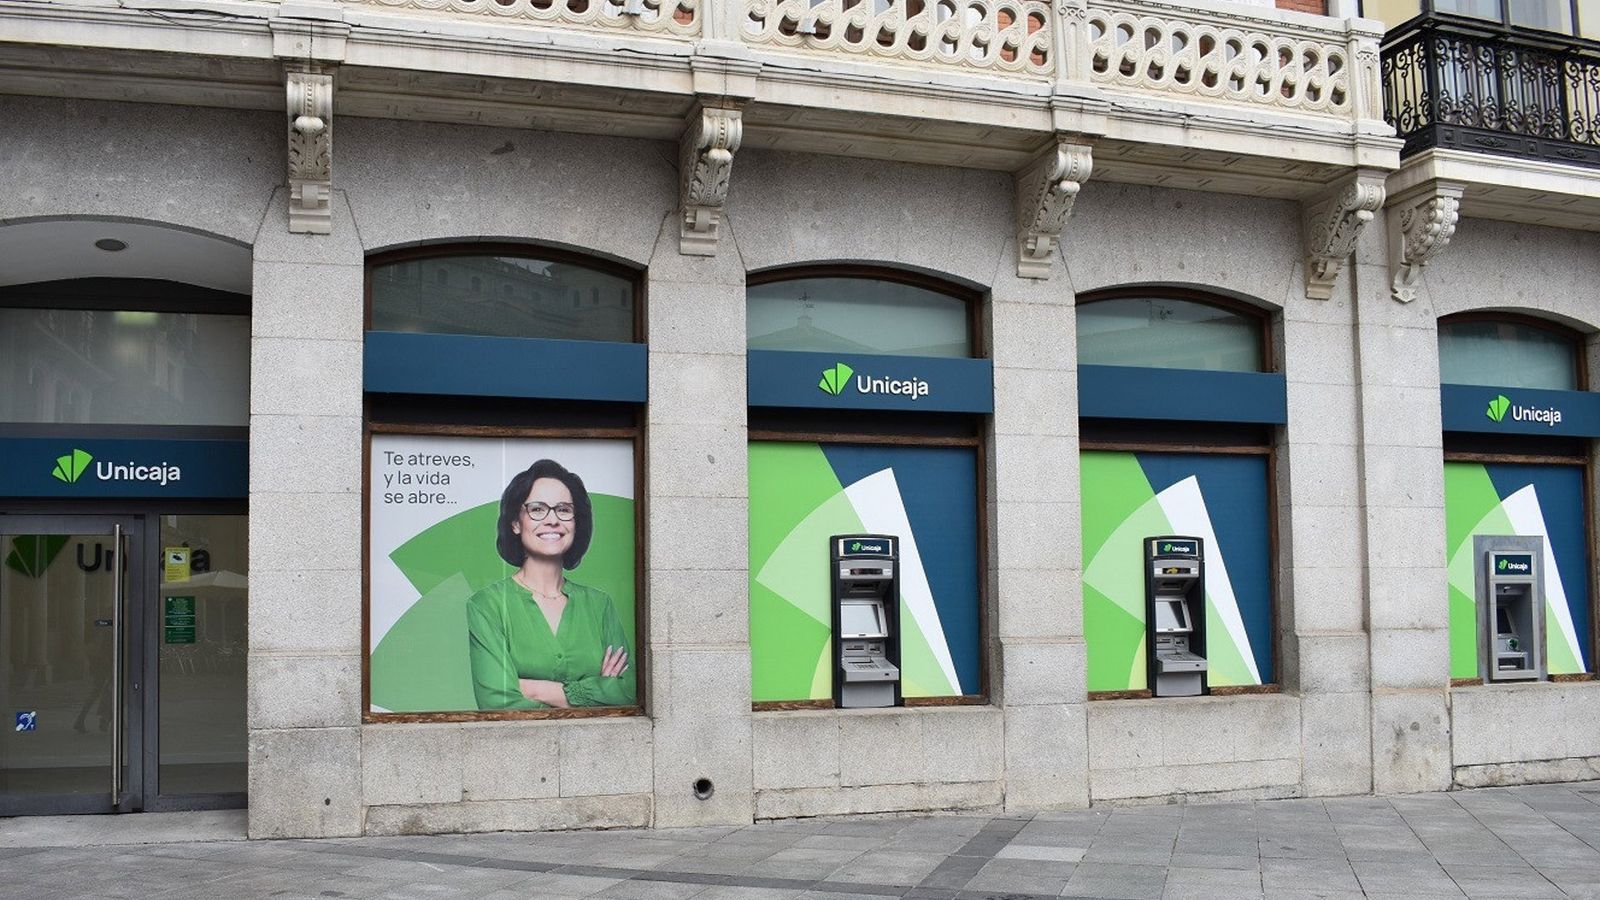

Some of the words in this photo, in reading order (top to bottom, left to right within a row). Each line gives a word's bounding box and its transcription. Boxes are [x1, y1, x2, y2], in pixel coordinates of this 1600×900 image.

[857, 375, 929, 400] Unicaja
[1512, 405, 1562, 427] Unicaja
[383, 450, 404, 466] Te
[407, 452, 475, 468] atreves,
[96, 461, 181, 486] Unicaja
[383, 473, 394, 489] y
[398, 470, 412, 485] la
[415, 471, 450, 486] vida
[383, 492, 404, 504] se
[407, 490, 457, 504] abre...
[1507, 562, 1528, 571] Unicaja
